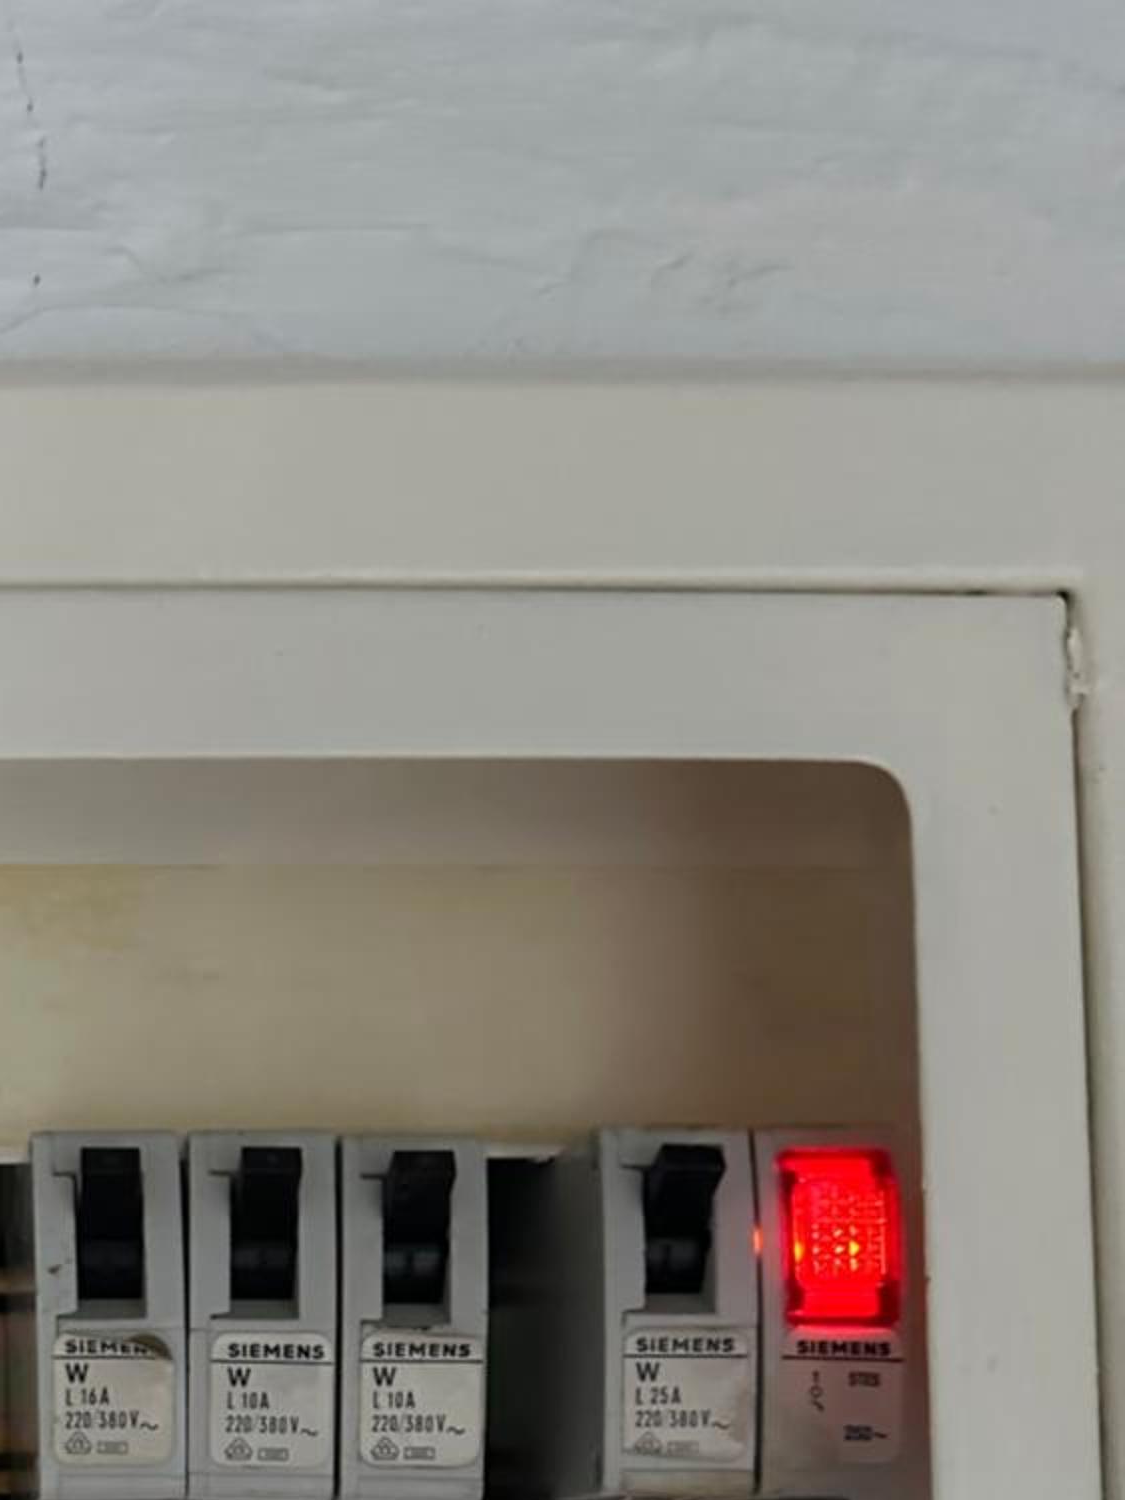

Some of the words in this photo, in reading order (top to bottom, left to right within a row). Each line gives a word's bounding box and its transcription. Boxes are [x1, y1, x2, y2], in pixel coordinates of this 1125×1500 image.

[228, 1343, 325, 1359] SIEMENS
[373, 1342, 471, 1358] SIEMENS
[636, 1338, 734, 1353] SIEMENS
[797, 1340, 891, 1356] SIEMENS
[65, 1363, 89, 1384] W
[227, 1367, 251, 1387] W
[373, 1367, 396, 1387] W
[636, 1362, 660, 1382] W
